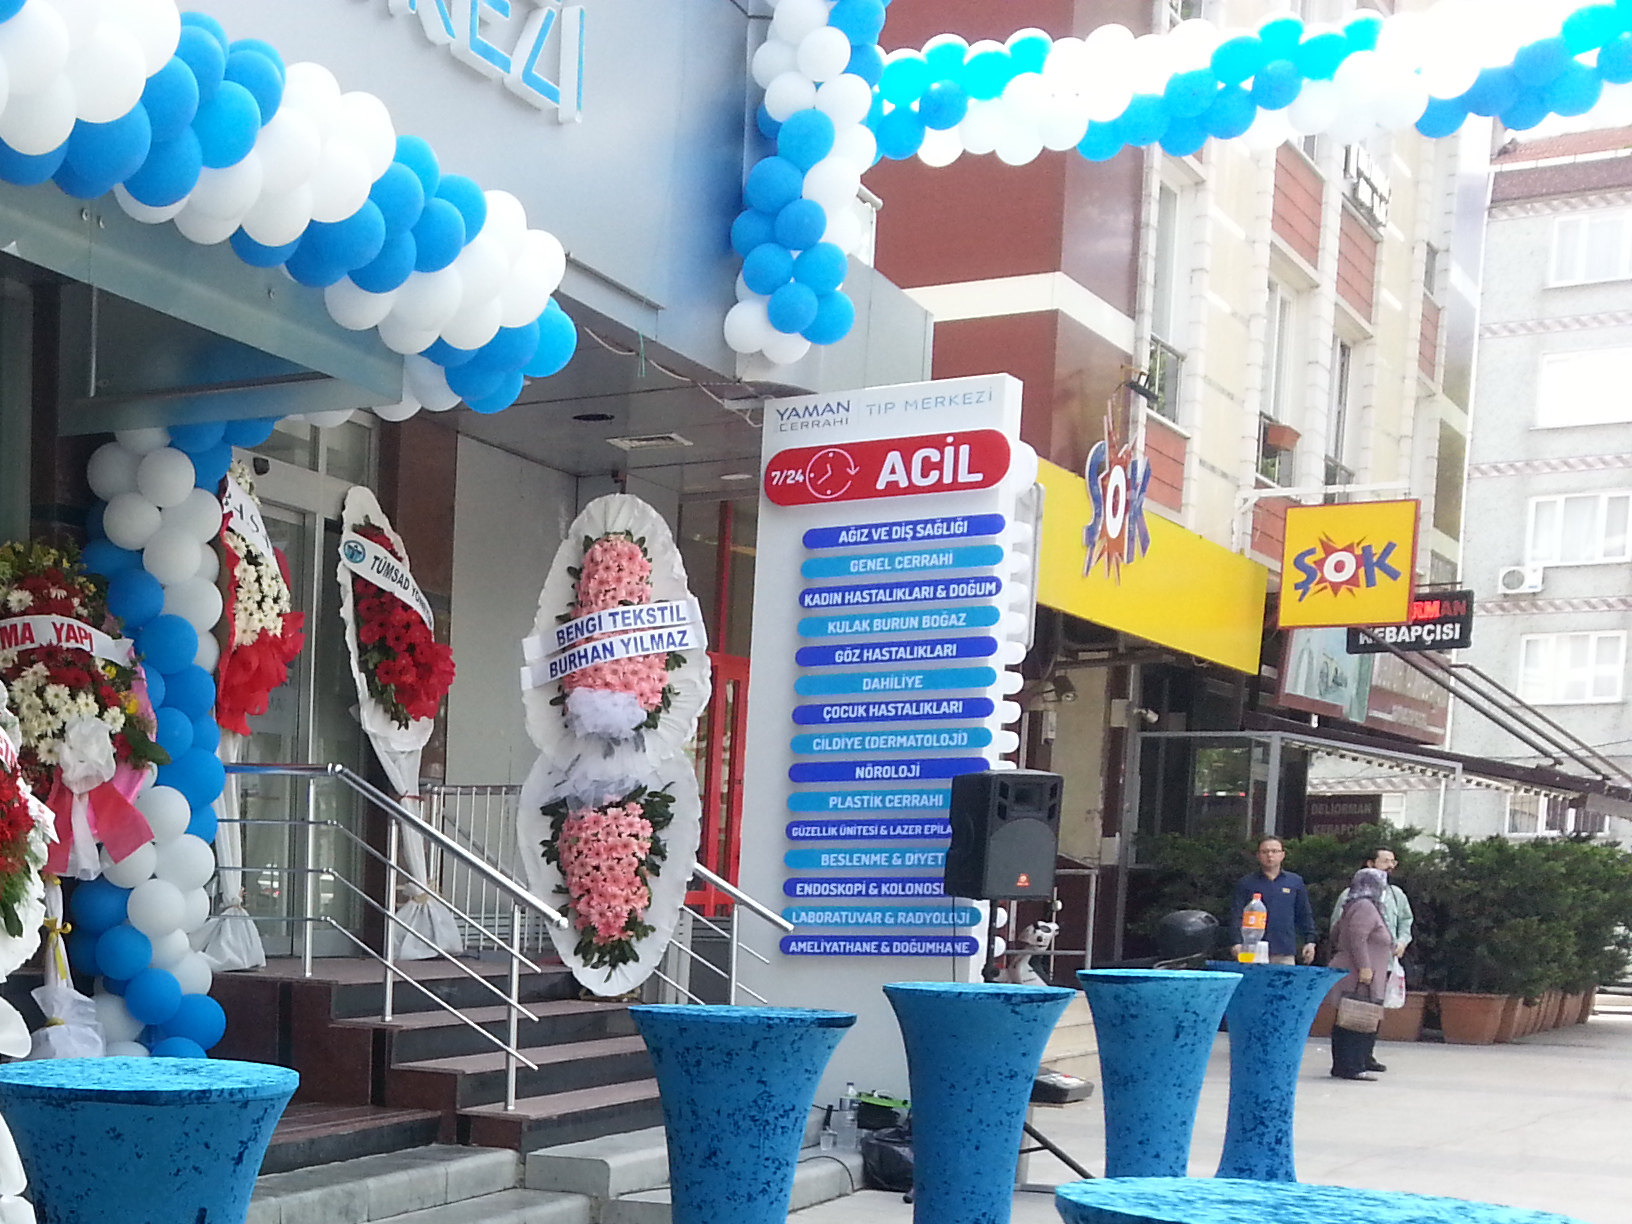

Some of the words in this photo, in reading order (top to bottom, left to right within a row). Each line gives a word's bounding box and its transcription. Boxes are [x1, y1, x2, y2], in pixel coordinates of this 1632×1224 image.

[776, 400, 850, 421] YAMAN
[866, 403, 896, 417] TIP
[771, 469, 805, 485] 7/24
[875, 436, 984, 490] ACİL
[839, 528, 868, 543] AĞIZ
[872, 527, 889, 541] VE
[892, 523, 913, 541] DİŞ
[916, 517, 968, 537] SAĞLIĞI
[850, 558, 891, 573] GENEL
[1293, 541, 1402, 602] ŞOK
[804, 593, 842, 607] KADIN
[844, 586, 934, 604] HASTALIKLARI
[936, 586, 947, 598] &
[950, 580, 997, 598] DOĞUM
[828, 619, 870, 634] KULAK
[873, 616, 918, 631] BURUN
[922, 611, 967, 628] BOĞAZ
[51, 621, 94, 653] YAPI
[549, 641, 615, 679] BURHAN
[620, 630, 689, 655] YILMAZ
[835, 648, 861, 663] GÖZ
[863, 644, 957, 661] HASTALIKLARI
[863, 674, 924, 690] DAHİLİYE
[823, 704, 867, 721] ÇOCUK
[869, 701, 963, 717] HASTALIKLARI
[880, 825, 888, 836] &
[889, 825, 922, 836] LAZER
[821, 853, 889, 867] BESLENME
[892, 853, 902, 865] &
[868, 883, 879, 895] &
[792, 911, 882, 925] LABORATUVAR
[884, 911, 895, 924] &
[789, 939, 878, 953] AMELİYATHANE
[880, 941, 890, 953] &
[893, 938, 971, 954] DOĞUMHANE
